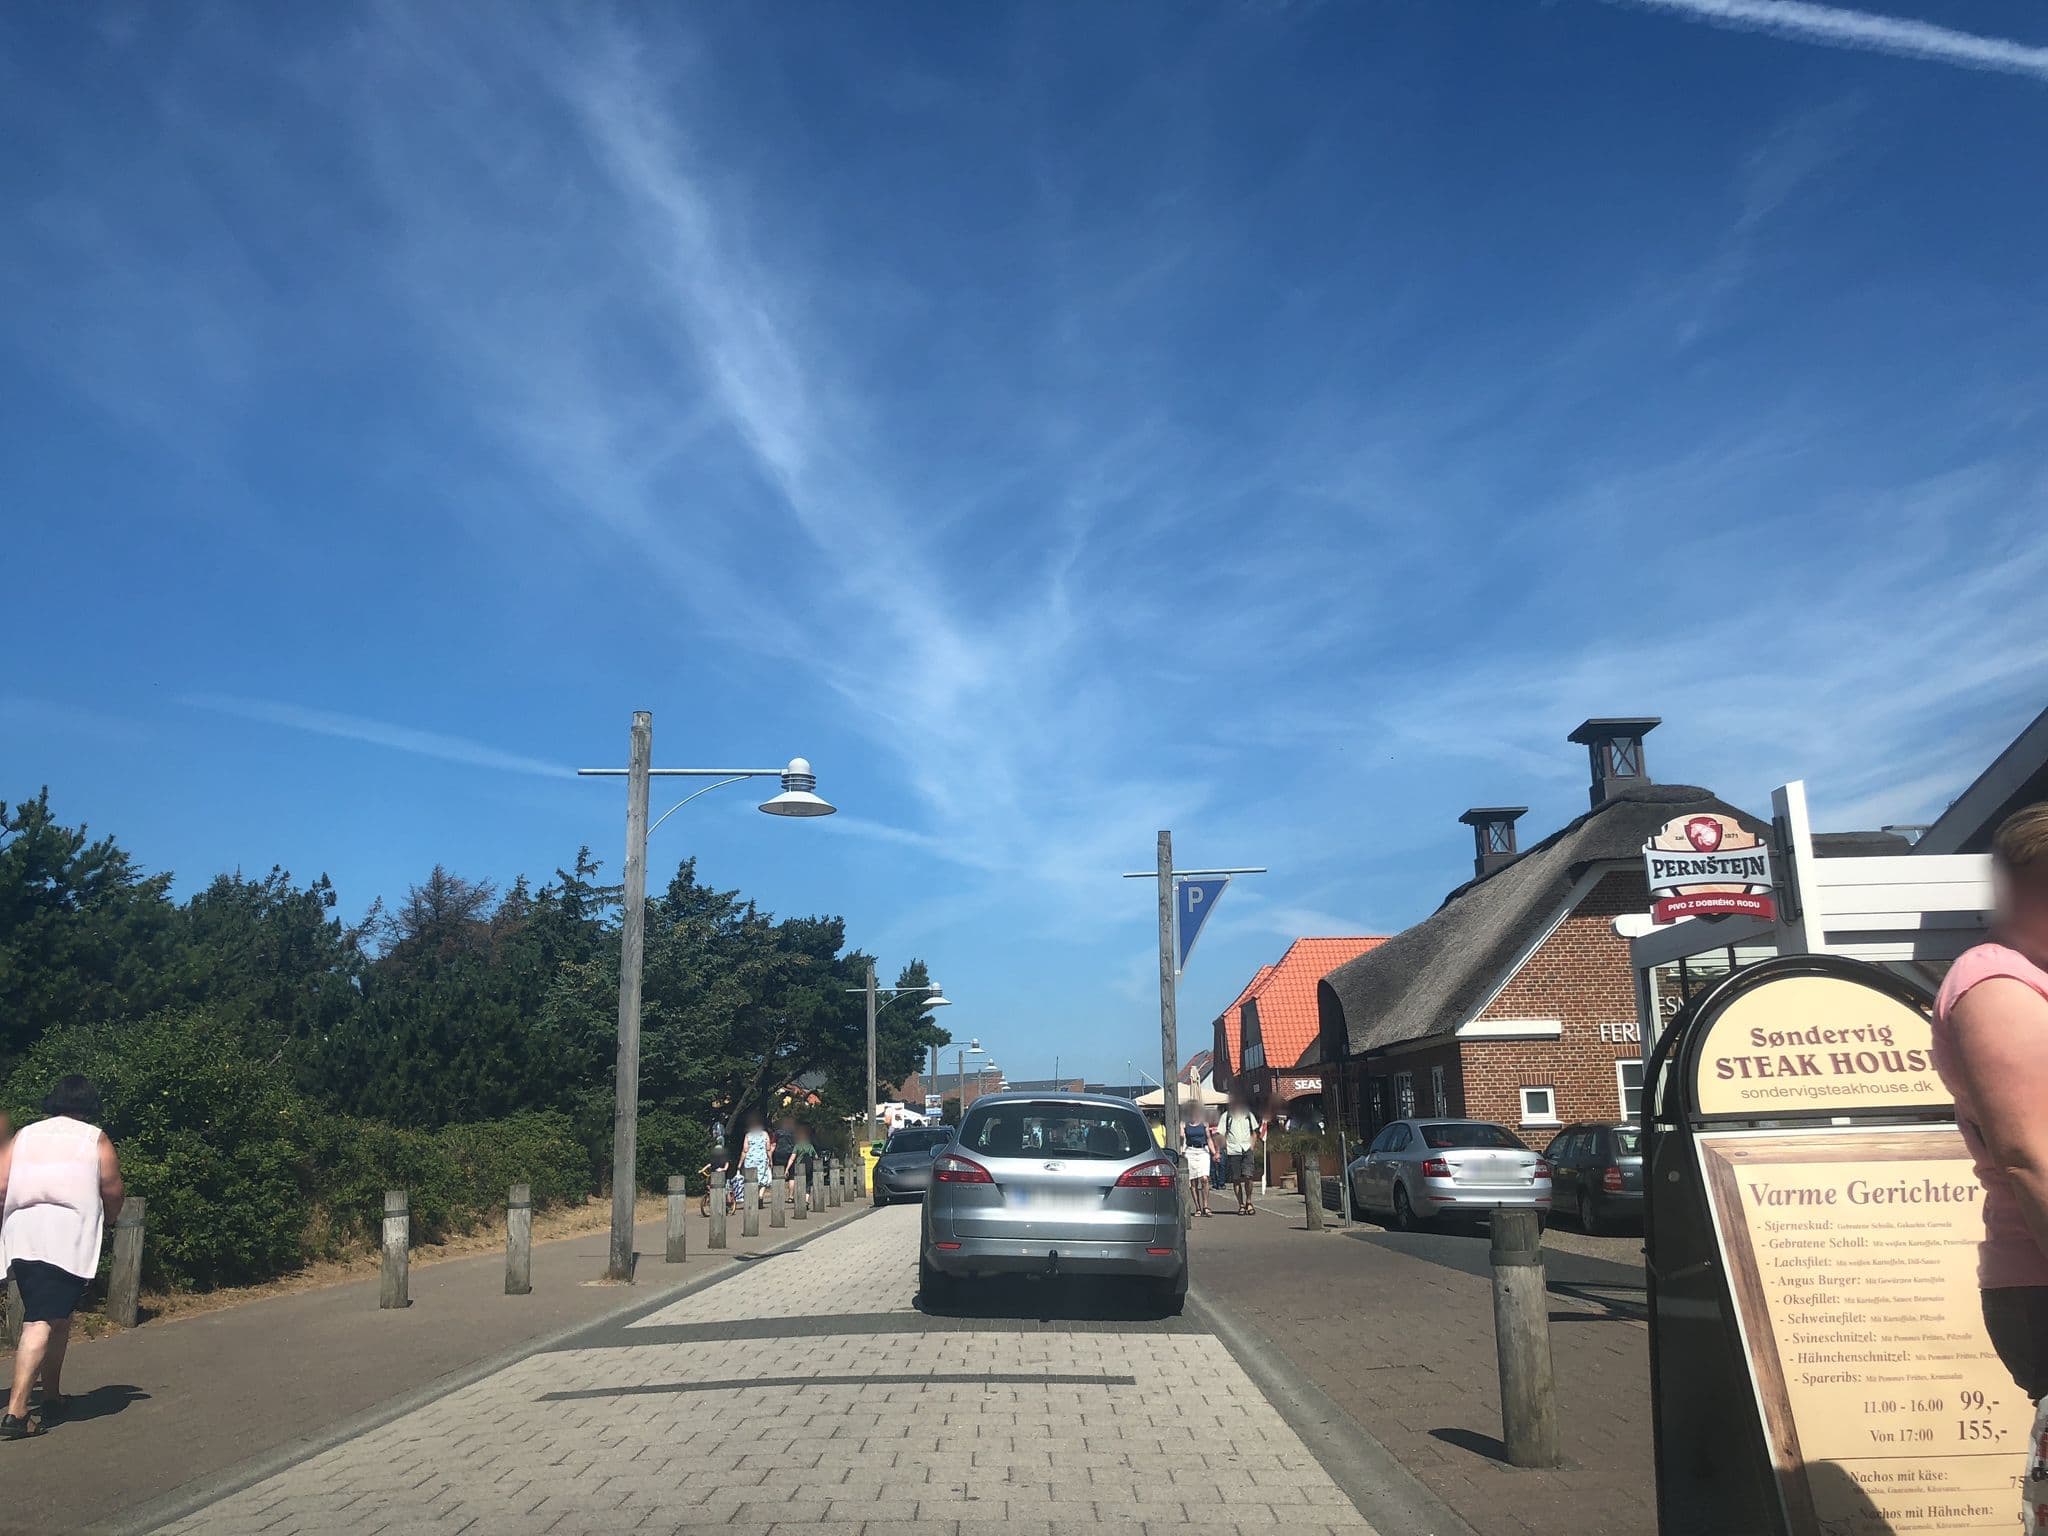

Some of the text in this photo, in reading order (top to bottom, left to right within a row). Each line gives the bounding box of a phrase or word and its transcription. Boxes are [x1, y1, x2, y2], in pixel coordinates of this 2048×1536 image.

[1651, 855, 1766, 880] PERNŠTEJN
[1188, 886, 1204, 913] P
[1667, 902, 1687, 911] PIVO
[1695, 898, 1735, 907] DOBRÉHO
[1737, 900, 1760, 909] RODU
[1750, 1023, 1895, 1048] Søndervig
[1715, 1054, 1824, 1080] STEAK
[1294, 1079, 1322, 1090] SEAS
[1740, 1079, 1935, 1099] sondervigsteakhouse.dk
[1748, 1178, 1980, 1207] Varme Gerichter
[1764, 1220, 1833, 1233] Stjerneskud:
[1769, 1238, 1826, 1249] Gebratene
[1829, 1236, 1869, 1249] Scholl:
[1774, 1256, 1833, 1269] Lachsfilet:
[1778, 1275, 1815, 1288] Angus
[1818, 1275, 1861, 1288] Burger:
[1783, 1293, 1840, 1307] Oksefillet:
[1787, 1312, 1867, 1325] Schweinefilet:
[1792, 1331, 1877, 1344] Svineschnitzel:
[1797, 1350, 1912, 1364] Hähnchenschnitzel:
[1802, 1371, 1862, 1387] Spareribs:
[1864, 1400, 1897, 1414] 11.00
[1910, 1399, 1944, 1412] 16.00
[1960, 1390, 2000, 1415] 99,-
[1870, 1420, 2008, 1444] Von 17:00 155,-
[1850, 1470, 1894, 1483] Nachos
[1897, 1470, 1916, 1482] mit
[1918, 1469, 1948, 1481] käse:
[1905, 1506, 1924, 1519] mit
[1928, 1504, 1994, 1518] Hähnchen:
